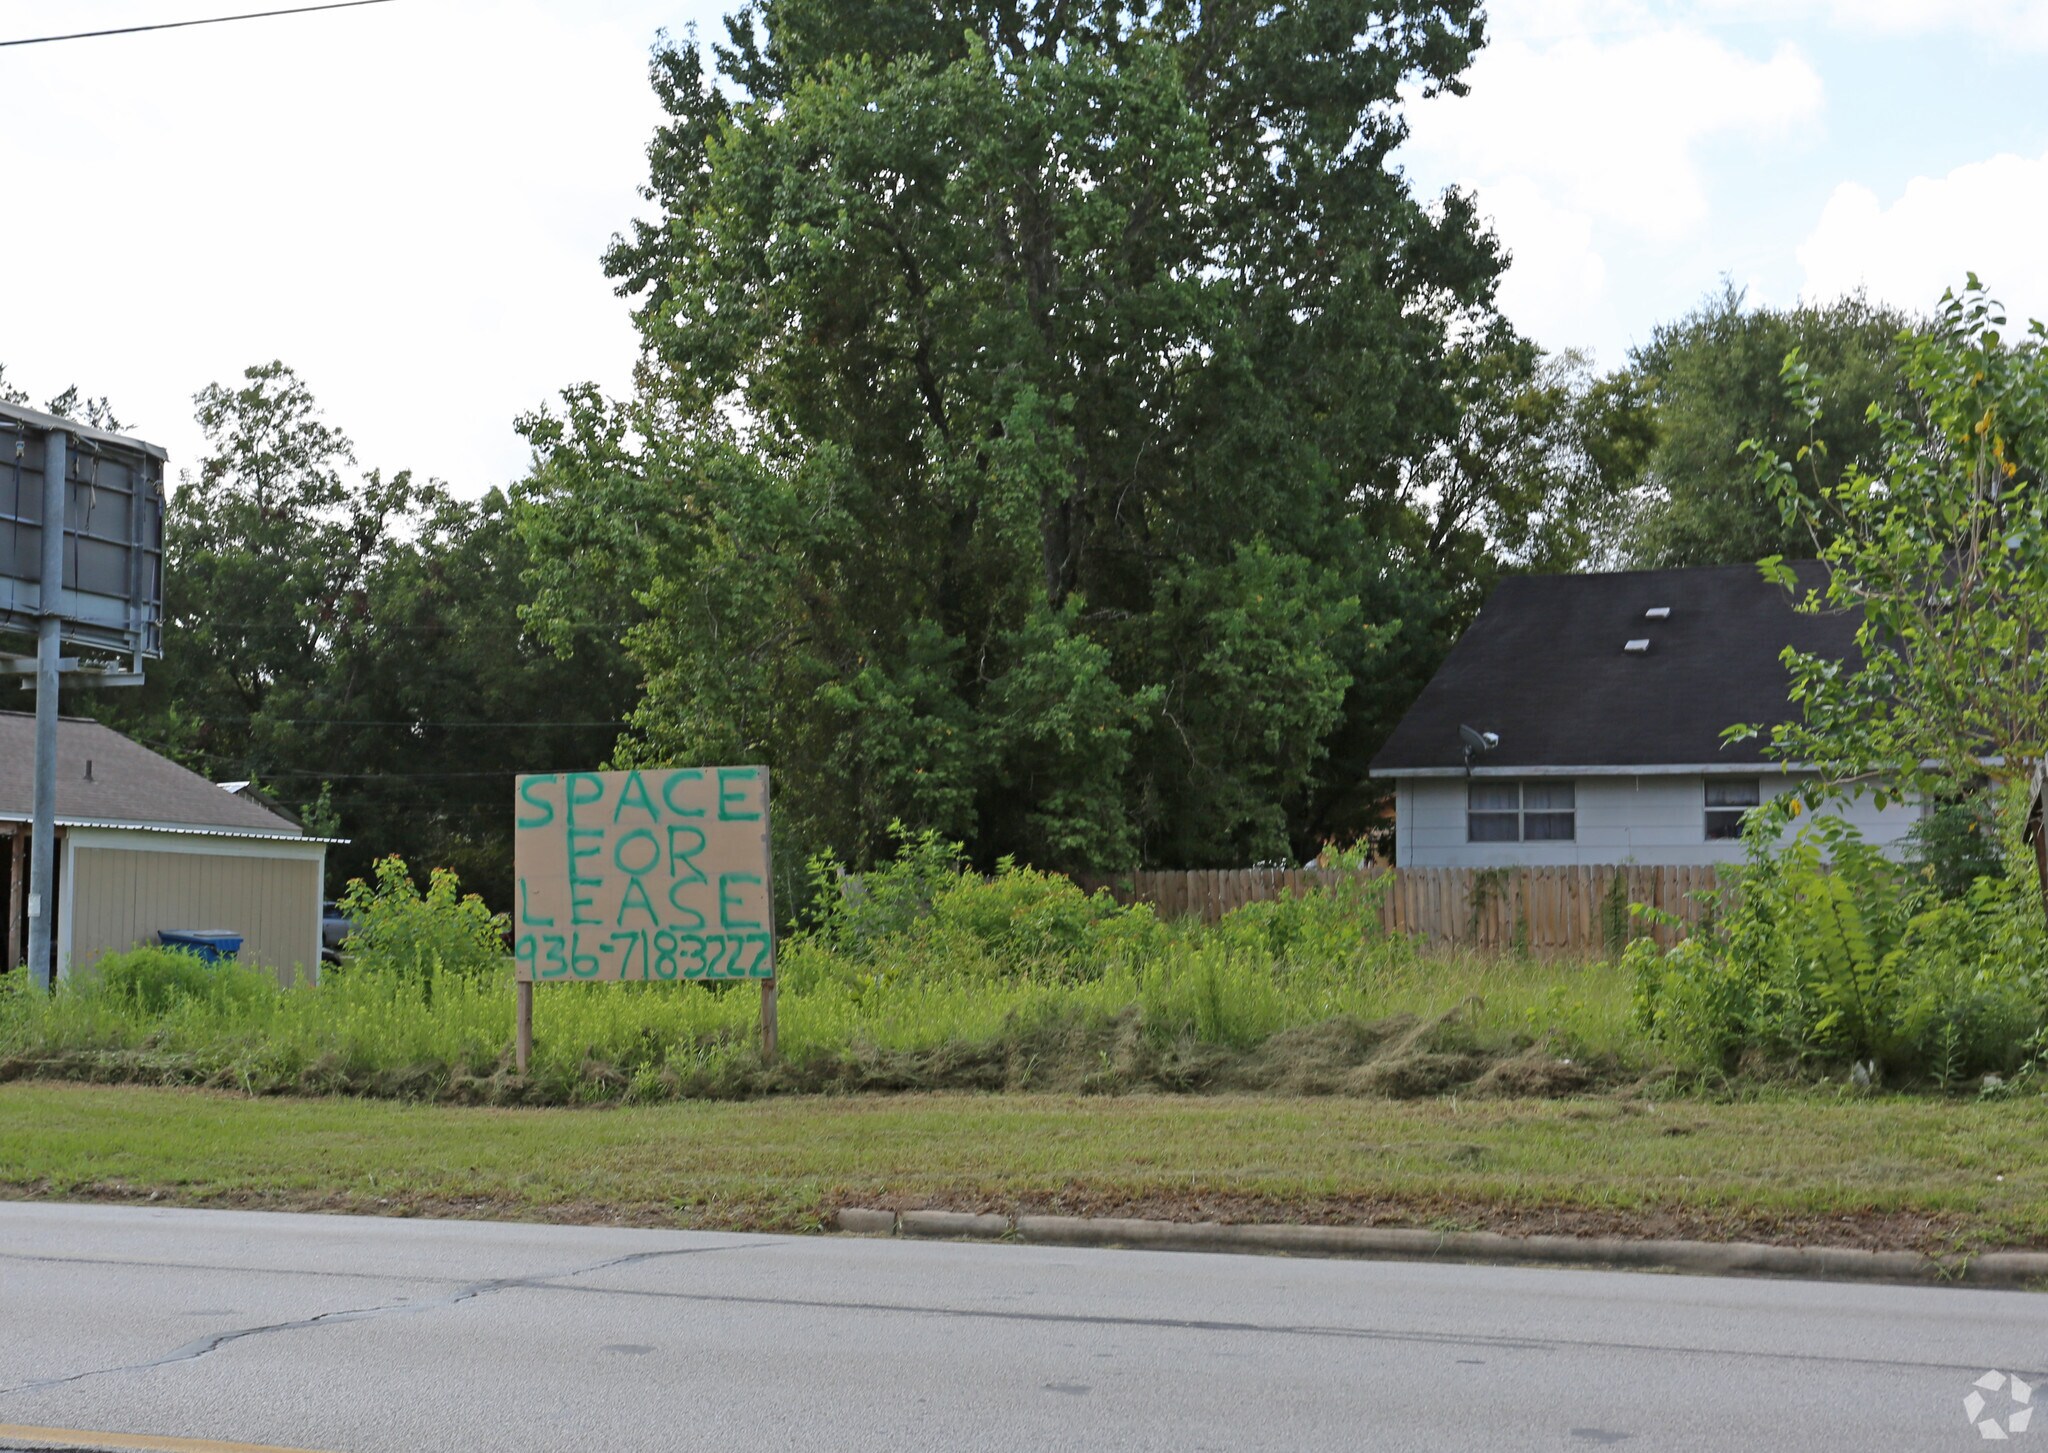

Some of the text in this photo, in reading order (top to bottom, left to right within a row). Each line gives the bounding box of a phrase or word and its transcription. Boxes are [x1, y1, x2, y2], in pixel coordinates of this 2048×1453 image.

[518, 769, 761, 829] SPACE
[567, 825, 708, 883] FOR
[520, 873, 761, 931] LEASE
[515, 929, 773, 980] 936-718-3222
